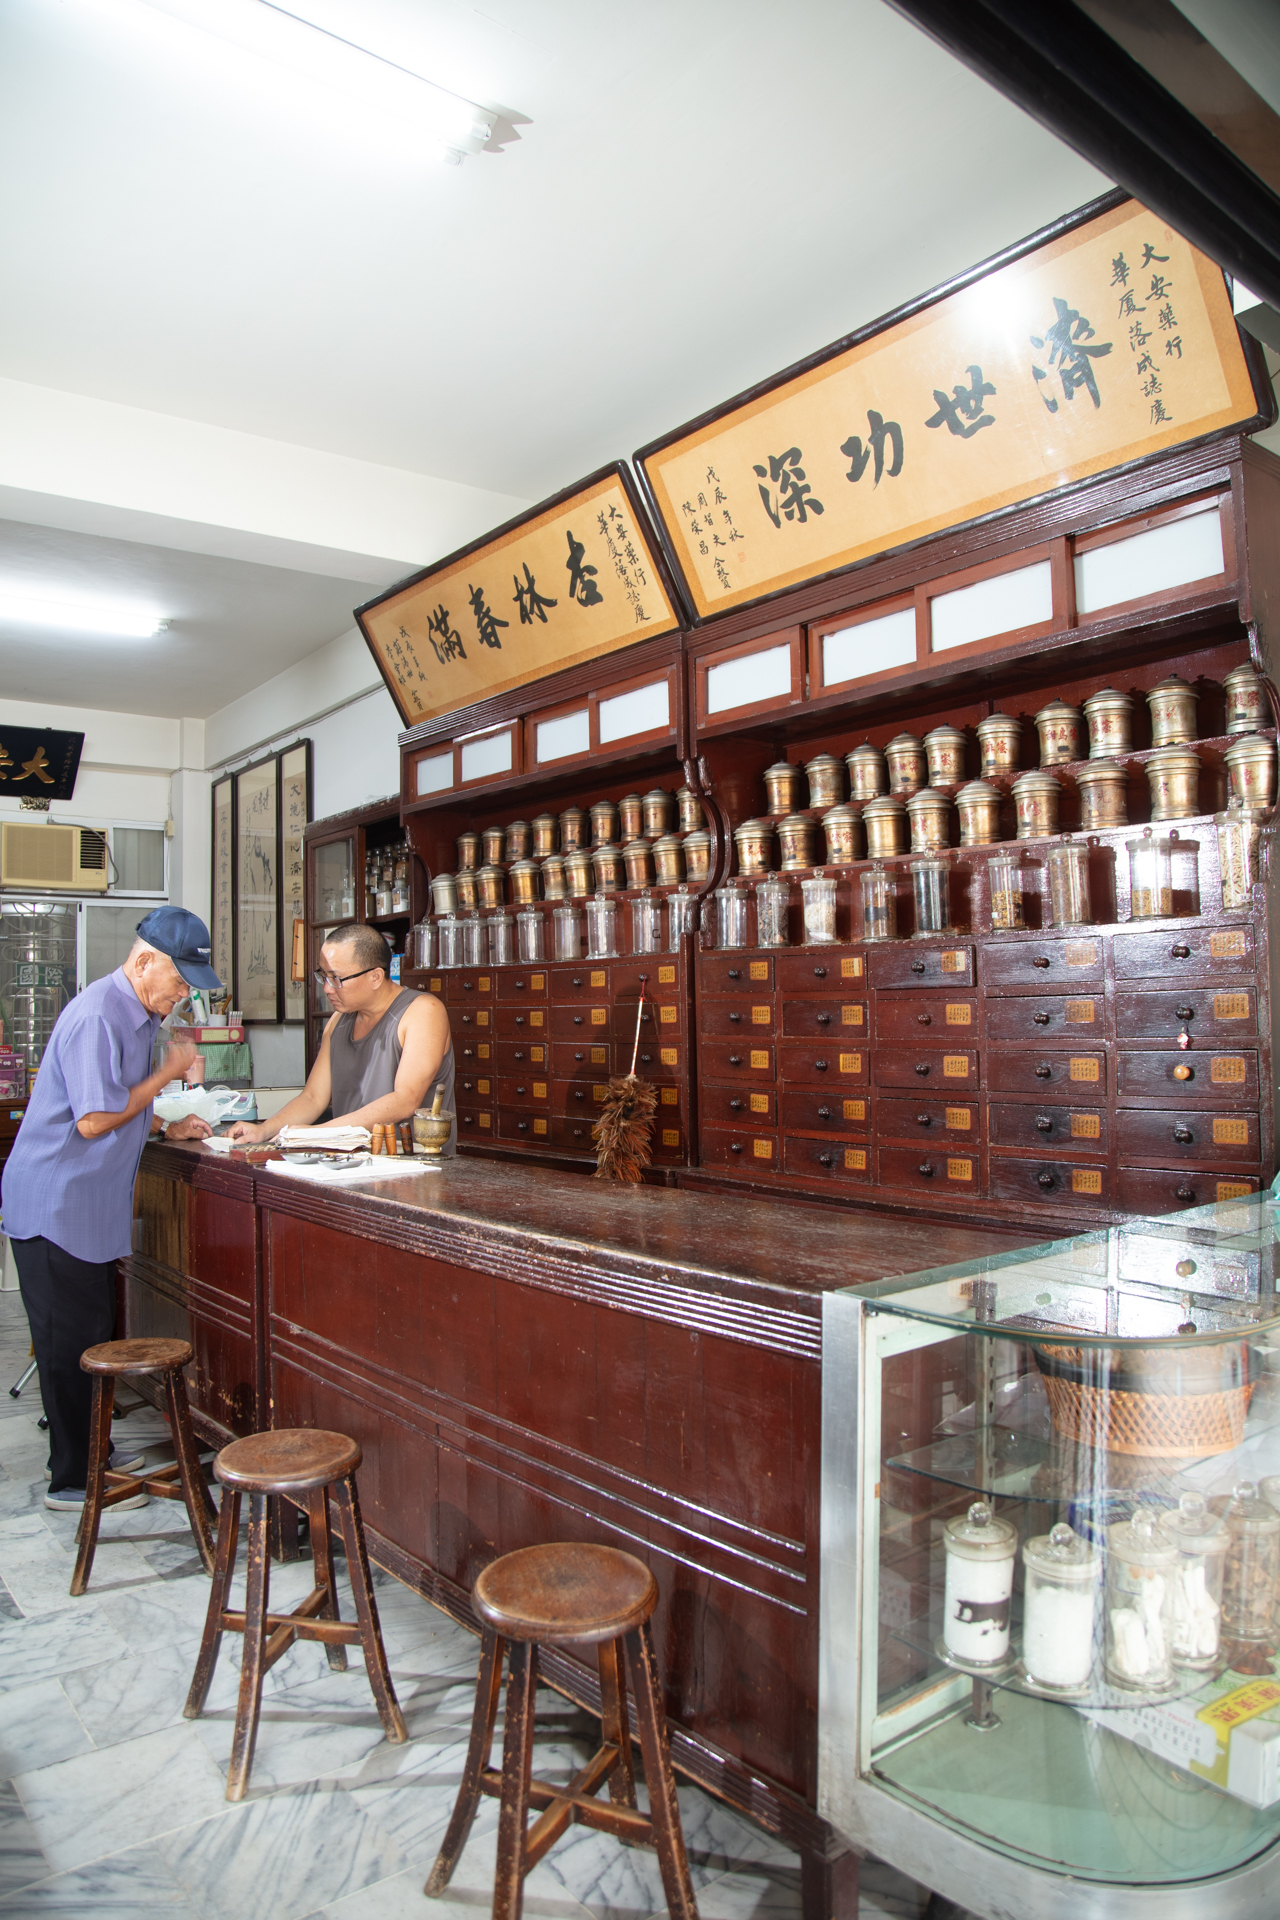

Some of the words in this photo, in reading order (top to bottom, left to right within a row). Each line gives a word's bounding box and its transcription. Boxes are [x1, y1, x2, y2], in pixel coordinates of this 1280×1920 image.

[1140, 243, 1183, 359] 大安藥行
[752, 296, 1113, 530] 濟世功深
[426, 530, 604, 665] 杏林春滿
